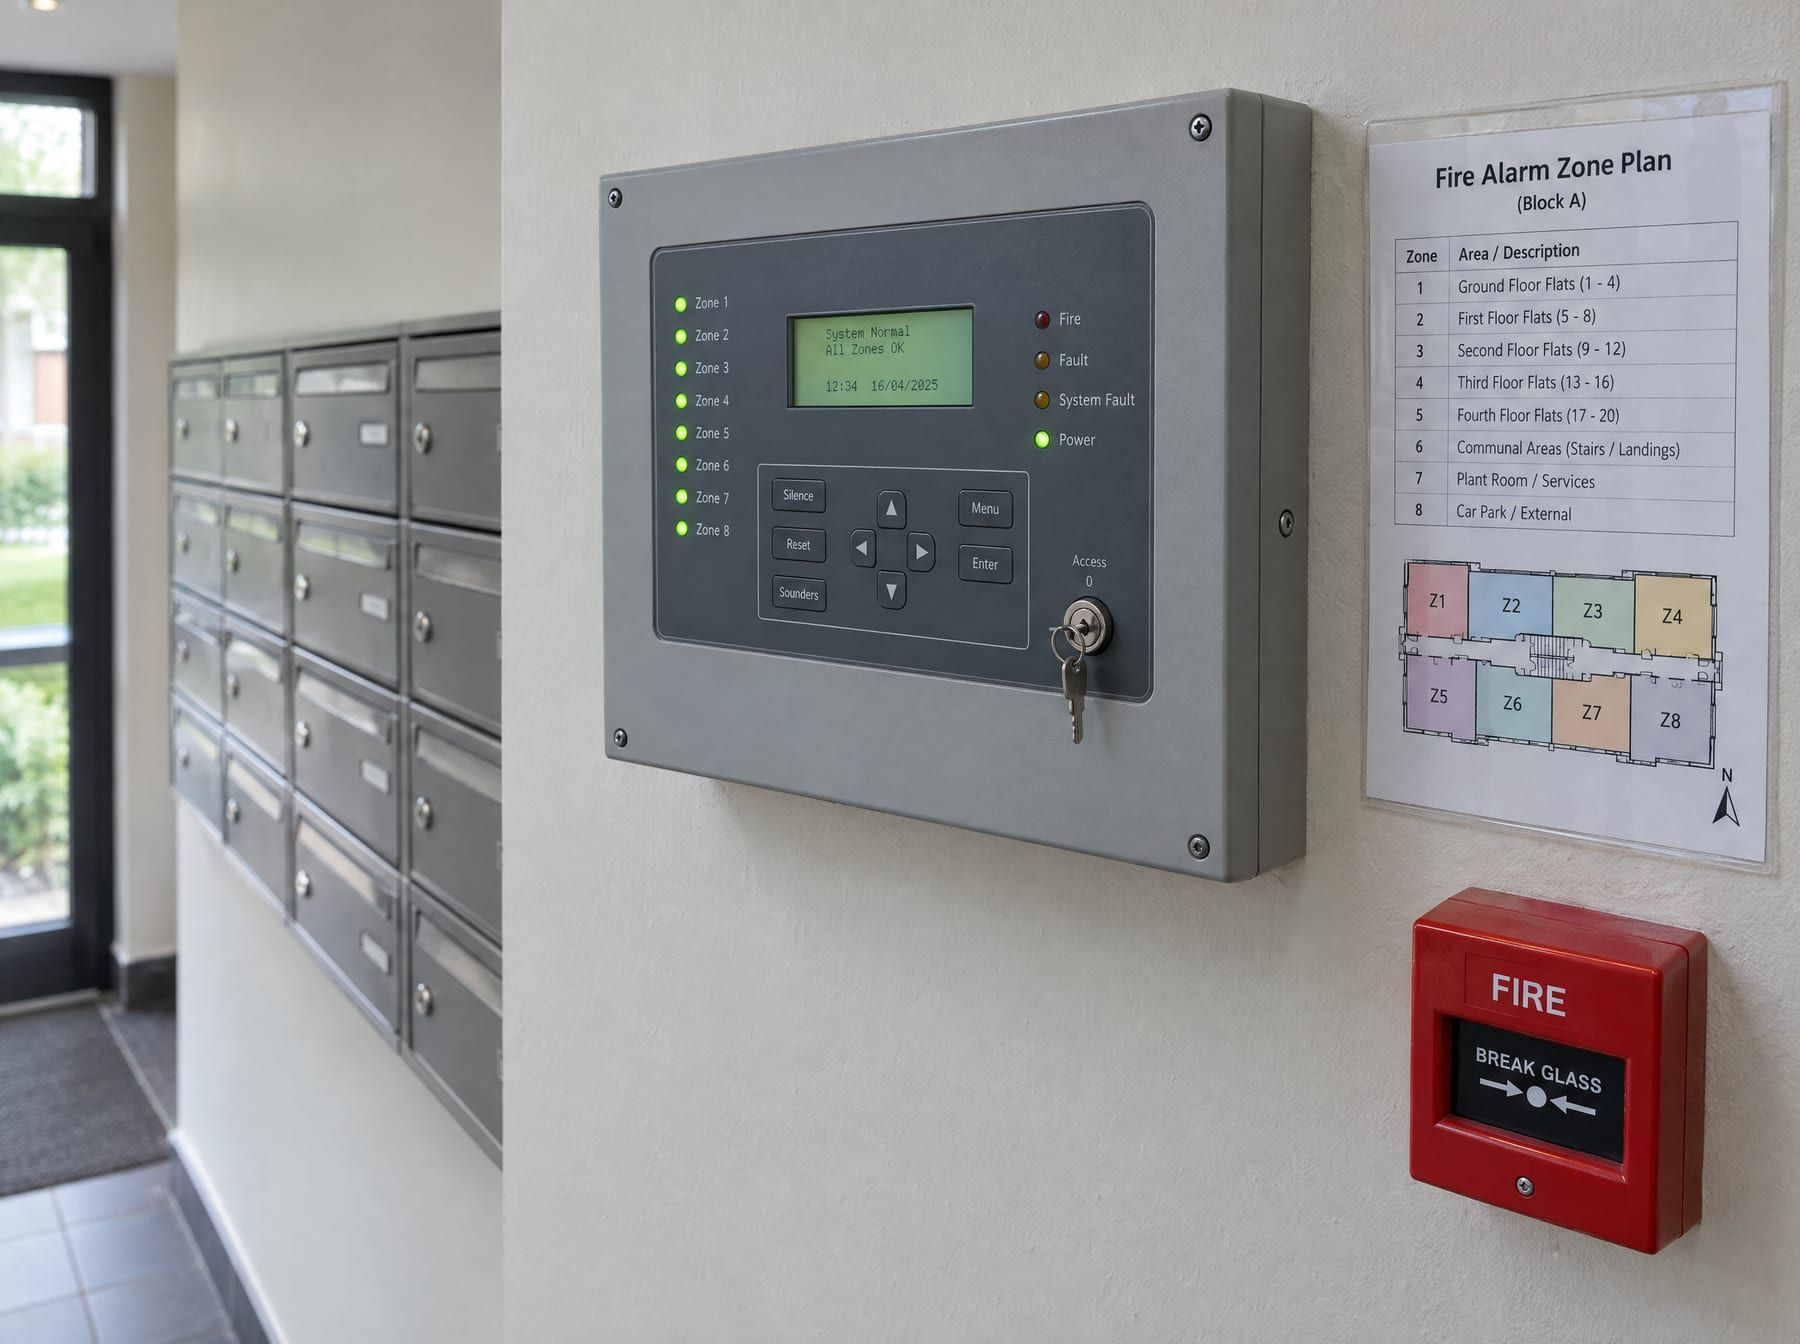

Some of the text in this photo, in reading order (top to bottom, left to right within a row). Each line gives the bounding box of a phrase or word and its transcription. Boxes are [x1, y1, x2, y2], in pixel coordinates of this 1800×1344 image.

[1437, 150, 1671, 188] Fire Alarm Zone Plan
[1518, 192, 1586, 214] (Block A)
[1407, 250, 1437, 263] Zone
[1459, 243, 1579, 262] Area / Description
[1418, 282, 1422, 294] 1
[1459, 279, 1504, 293] Ground
[1509, 278, 1541, 292] Floor
[1546, 277, 1575, 291] Flats
[1580, 276, 1590, 293] (1
[1607, 275, 1620, 291] 4)
[696, 296, 727, 309] Zone 1
[1060, 312, 1080, 325] Fire
[1417, 313, 1423, 326] 2
[1459, 312, 1483, 325] First
[1488, 311, 1519, 324] Floor
[1524, 310, 1552, 324] Flats
[1557, 309, 1568, 326] (5
[1584, 309, 1595, 325] 8)
[696, 329, 728, 341] Zone 2
[826, 325, 910, 342] System Normal
[826, 342, 904, 355] All Zones OK
[1417, 345, 1423, 357] 3
[1458, 343, 1502, 357] Second
[1508, 343, 1539, 356] Floor
[1544, 342, 1572, 356] Flats
[1578, 342, 1589, 358] (9
[1606, 341, 1625, 358] 12)
[1060, 353, 1088, 366] Fault
[696, 362, 728, 374] Zone 3
[827, 379, 938, 392] 12:34 16/04/2025
[1416, 376, 1423, 389] 4
[1458, 376, 1488, 389] Third
[1493, 376, 1523, 389] Floor
[1528, 375, 1556, 389] Flats
[1561, 375, 1580, 392] (13
[1595, 375, 1614, 392] 16)
[696, 395, 729, 406] Zone 4
[1060, 393, 1135, 409] System Fault
[1416, 408, 1423, 421] 5
[1458, 408, 1495, 422] Fourth
[1500, 408, 1530, 422] Floor
[1535, 408, 1562, 422] Flats
[1567, 408, 1586, 424] (17
[1600, 408, 1619, 424] 20)
[696, 427, 729, 439] Zone 5
[1060, 433, 1096, 446] Power
[1416, 440, 1422, 453] 6
[1458, 440, 1680, 460] Communal Areas (Stairs / Landings)
[696, 459, 729, 471] Zone 6
[1416, 472, 1422, 484] 7
[1458, 472, 1595, 488] Plant Room / Services
[696, 491, 729, 504] Zone 7
[784, 489, 813, 501] Silence
[972, 502, 999, 514] Menu
[1416, 503, 1422, 516] 8
[1457, 504, 1571, 521] Car Park / External
[696, 523, 729, 536] Zone 8
[787, 538, 810, 550] Reset
[973, 557, 998, 570] Enter
[1073, 555, 1106, 567] Access
[780, 587, 818, 600] Sounders
[1430, 593, 1444, 608] Z1
[1503, 598, 1520, 613] Z2
[1584, 603, 1602, 619] Z3
[1663, 608, 1682, 624] Z4
[1431, 688, 1447, 703] Z5
[1504, 696, 1521, 711] Z6
[1583, 704, 1601, 720] Z7
[1661, 712, 1680, 728] Z8
[1722, 768, 1732, 782] N
[1493, 973, 1565, 1017] FIRE
[1476, 1047, 1602, 1094] BREAK GLASS
